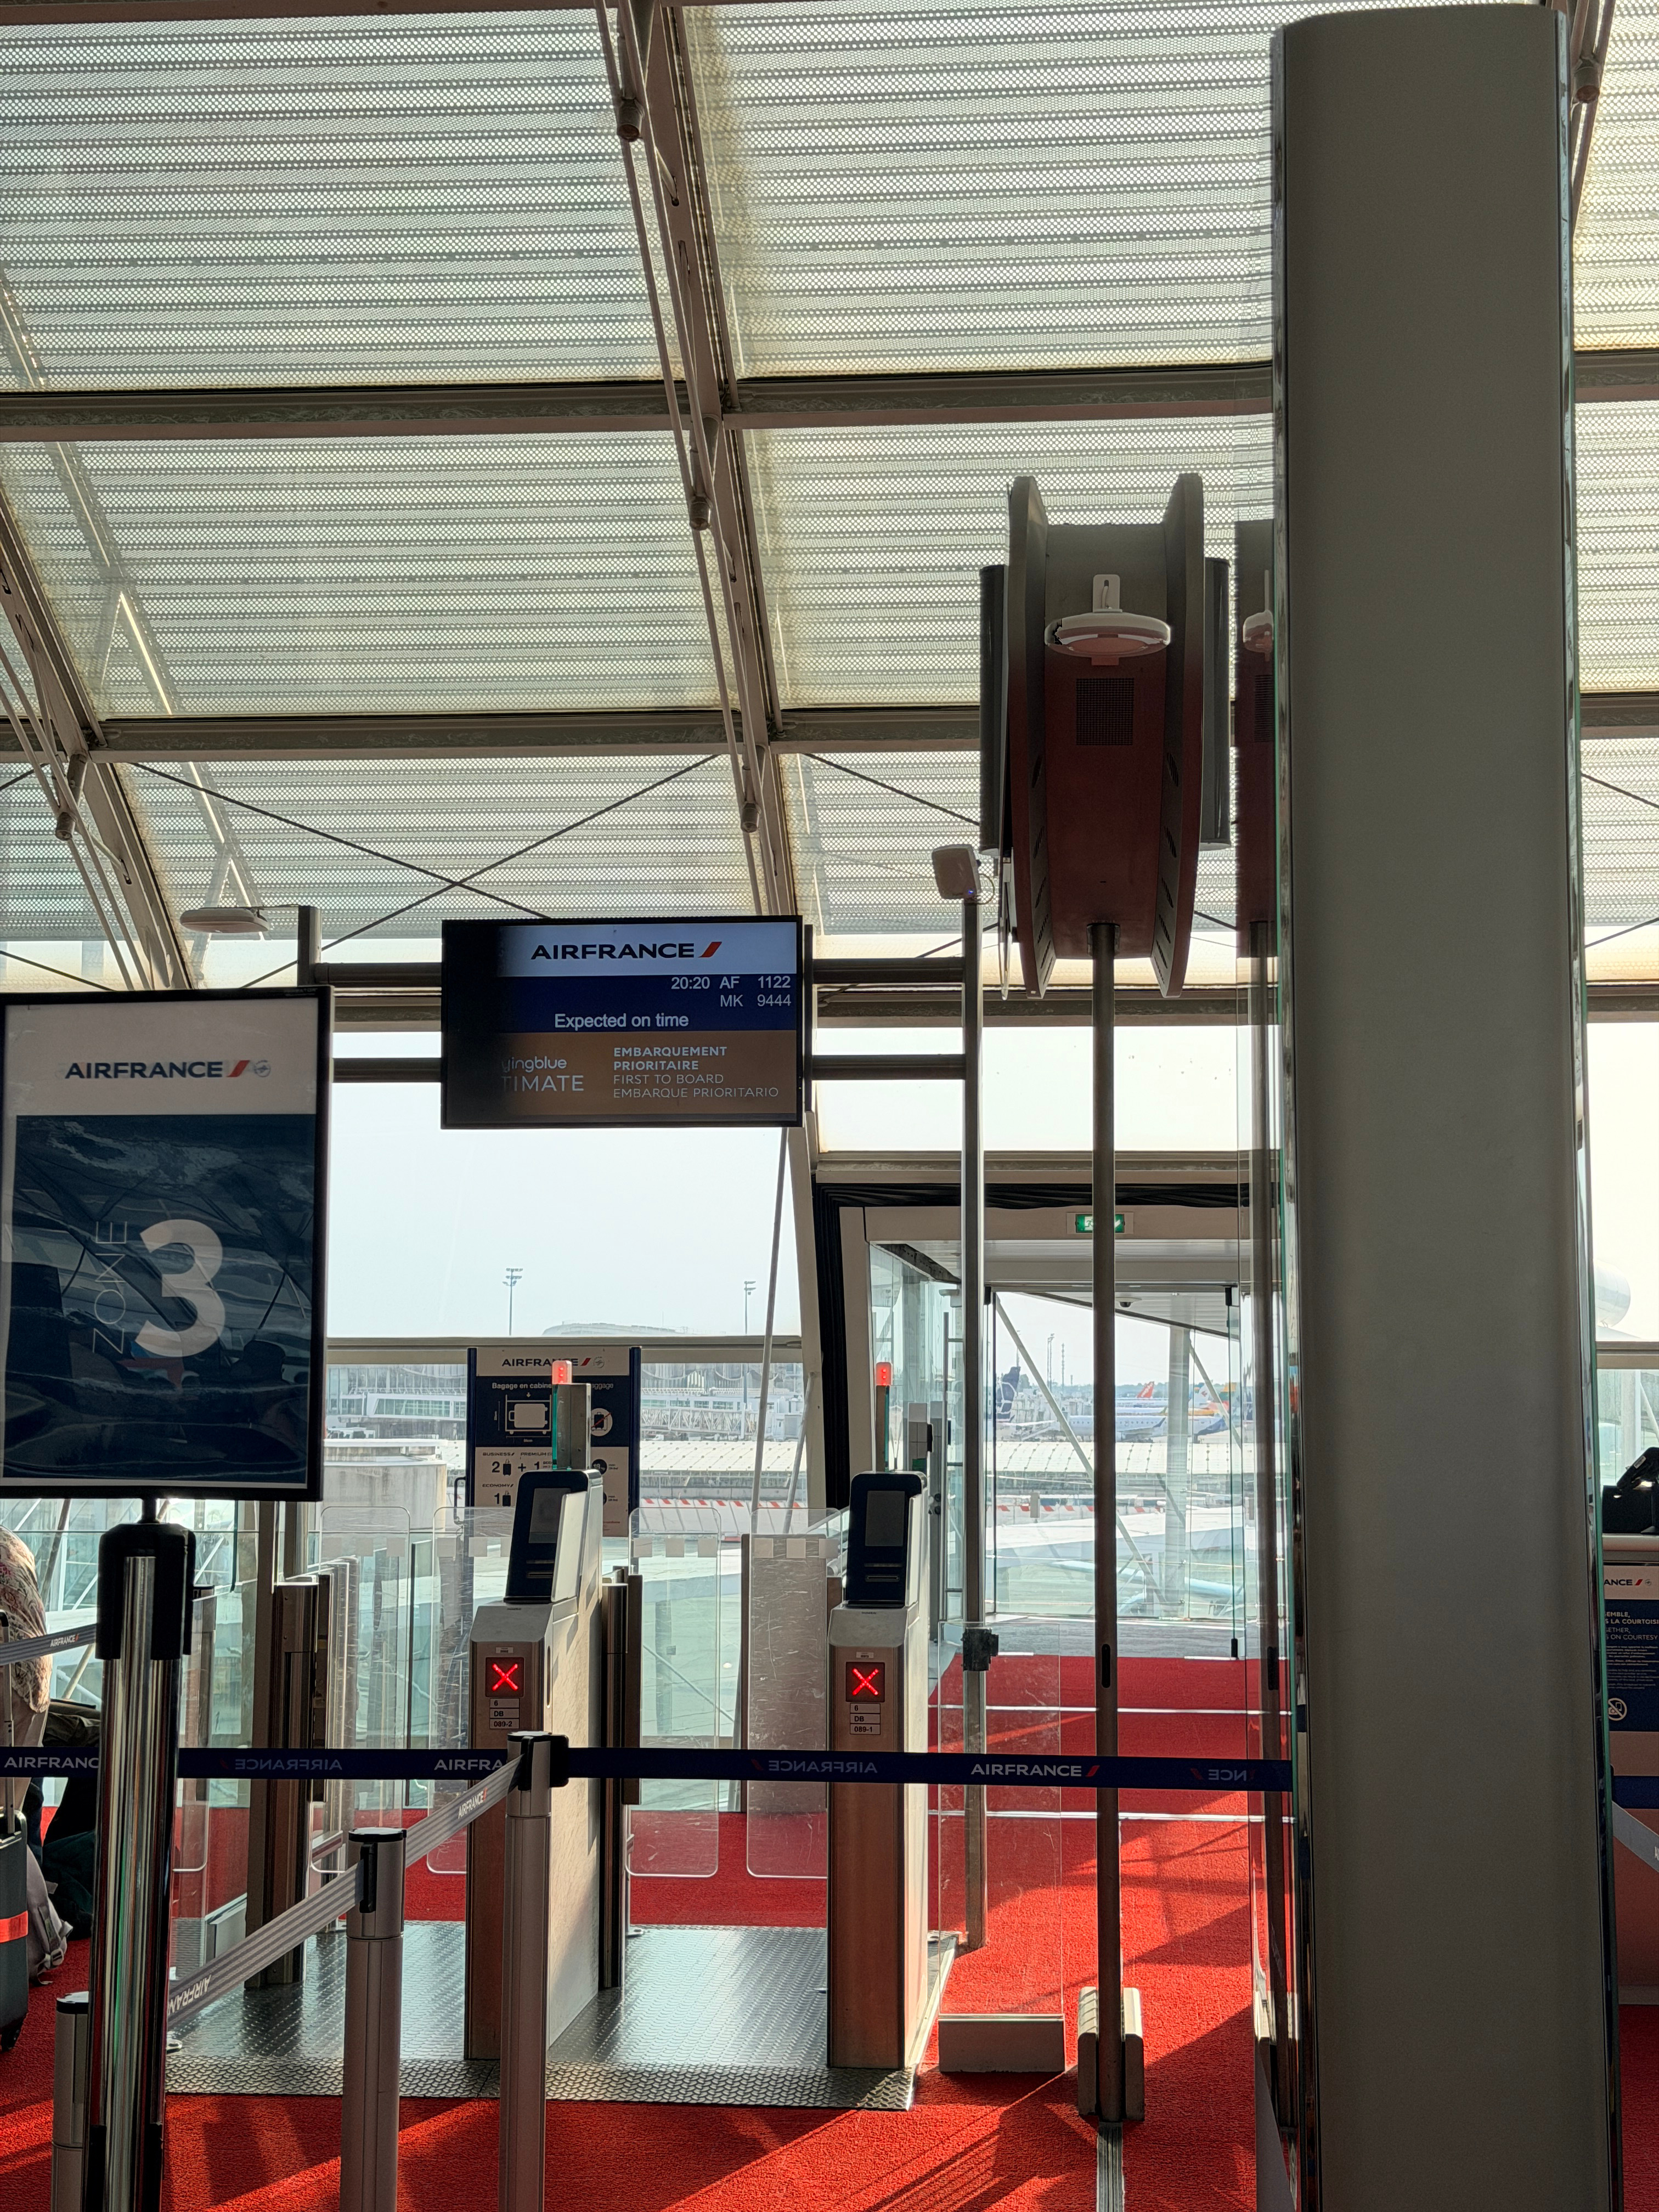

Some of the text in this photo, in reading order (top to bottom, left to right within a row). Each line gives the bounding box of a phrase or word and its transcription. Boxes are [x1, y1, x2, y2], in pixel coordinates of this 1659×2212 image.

[531, 943, 695, 960] AIRFRANCE
[671, 975, 791, 990] 20:20 AF 1122
[720, 994, 792, 1007] MK 9444
[554, 1012, 689, 1031] Expected on time
[613, 1046, 727, 1057] EMBARQUEMENT
[65, 1062, 223, 1079] AIRFRANCE
[613, 1060, 699, 1070] PRIORITAIRE
[613, 1074, 724, 1084] FIRST TO BOARD
[613, 1087, 779, 1098] EMBARQUE PRIORITARIO
[93, 1221, 127, 1354] ZONE
[134, 1218, 225, 1357] 3
[501, 1358, 579, 1367] AIRFRAE
[492, 1382, 518, 1391] Bagage
[492, 1461, 500, 1473] 2
[534, 1461, 540, 1470] 1
[494, 1493, 500, 1504] 1
[50, 1634, 75, 1647] AIRFRANCE
[4, 1757, 99, 1768] AIRFRANC
[971, 1764, 1082, 1777] AIRFRANCE
[458, 1791, 484, 1819] AIRFRANCE
